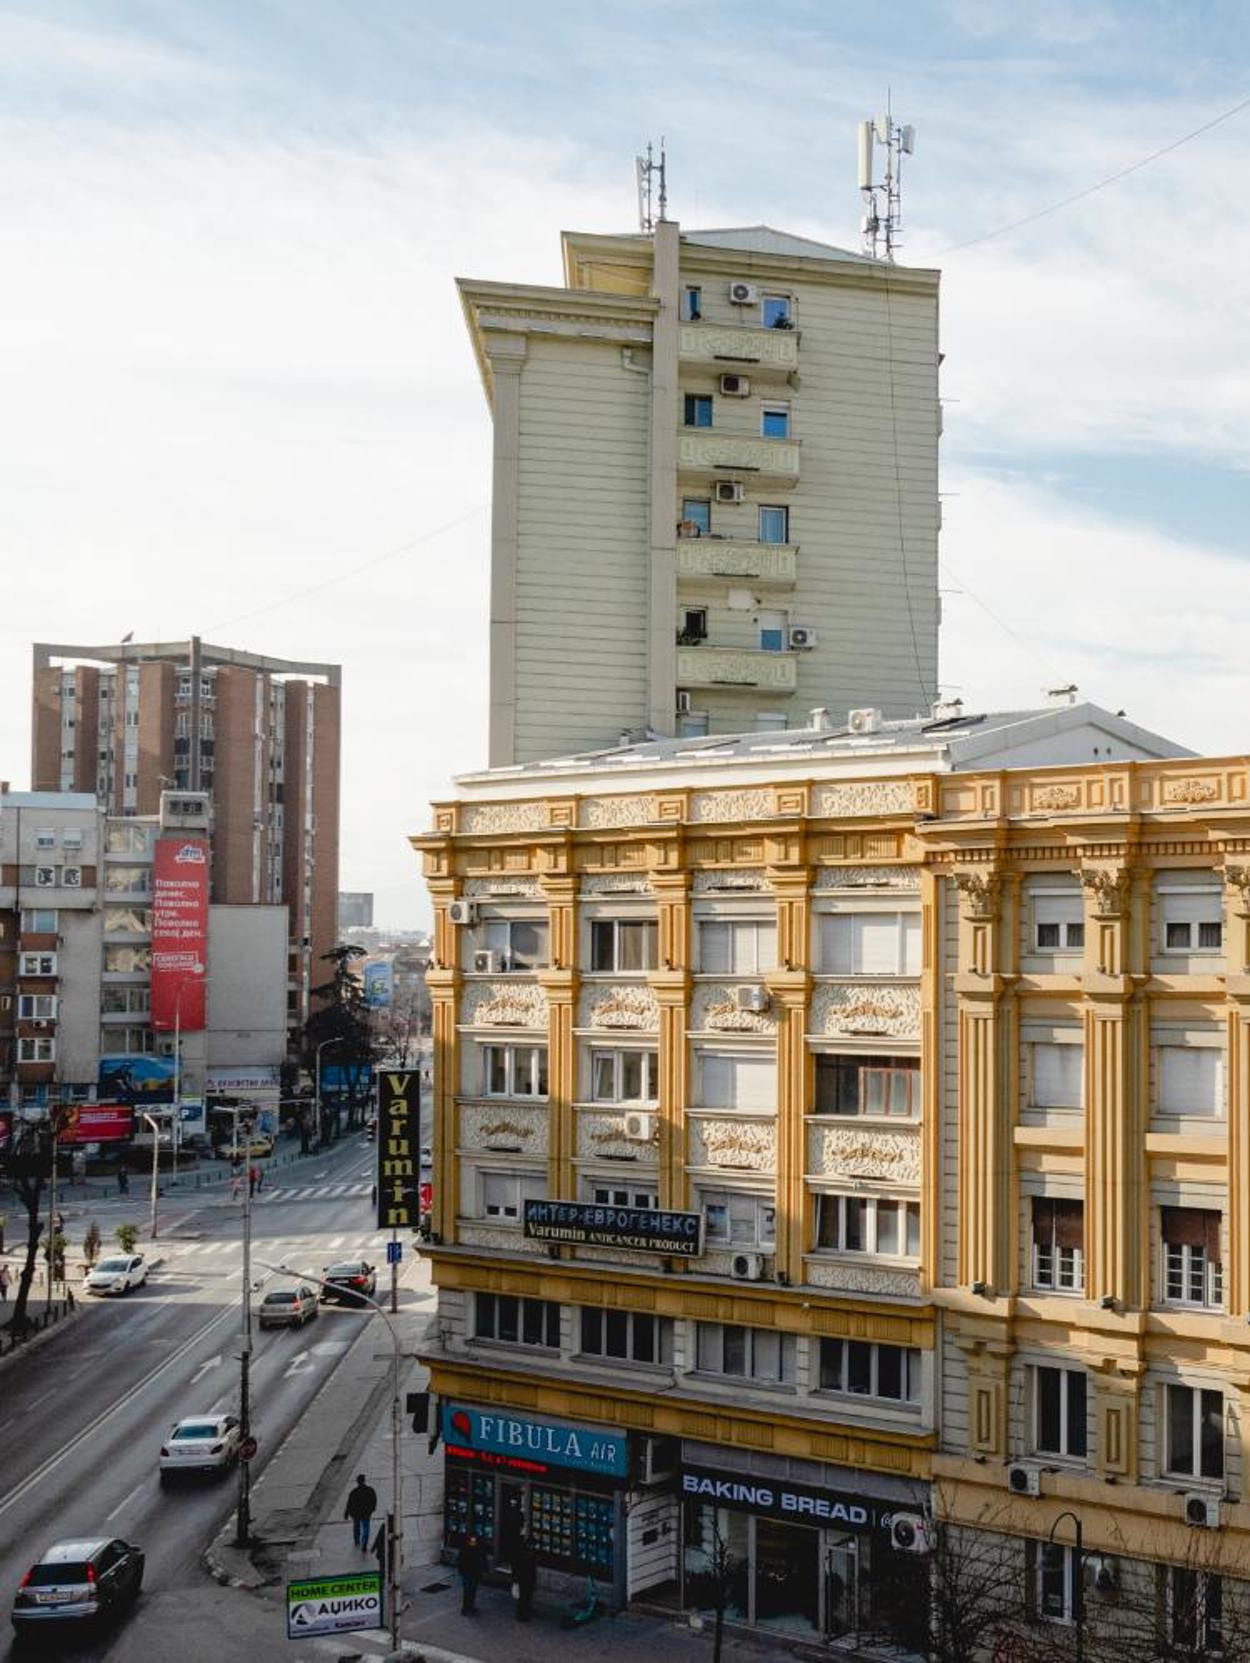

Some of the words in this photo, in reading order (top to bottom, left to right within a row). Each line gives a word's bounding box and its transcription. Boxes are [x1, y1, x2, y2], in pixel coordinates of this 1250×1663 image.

[383, 1074, 415, 1225] Varumin
[528, 1222, 586, 1241] Varumin
[589, 1232, 648, 1248] ANTICANCER
[648, 1239, 696, 1253] PRODUCT
[479, 1415, 583, 1458] FIBULA
[590, 1441, 617, 1464] AIR
[682, 1474, 774, 1507] BAKING
[781, 1492, 868, 1525] BREAD
[290, 1585, 329, 1598] HOME
[330, 1580, 377, 1594] CENTER
